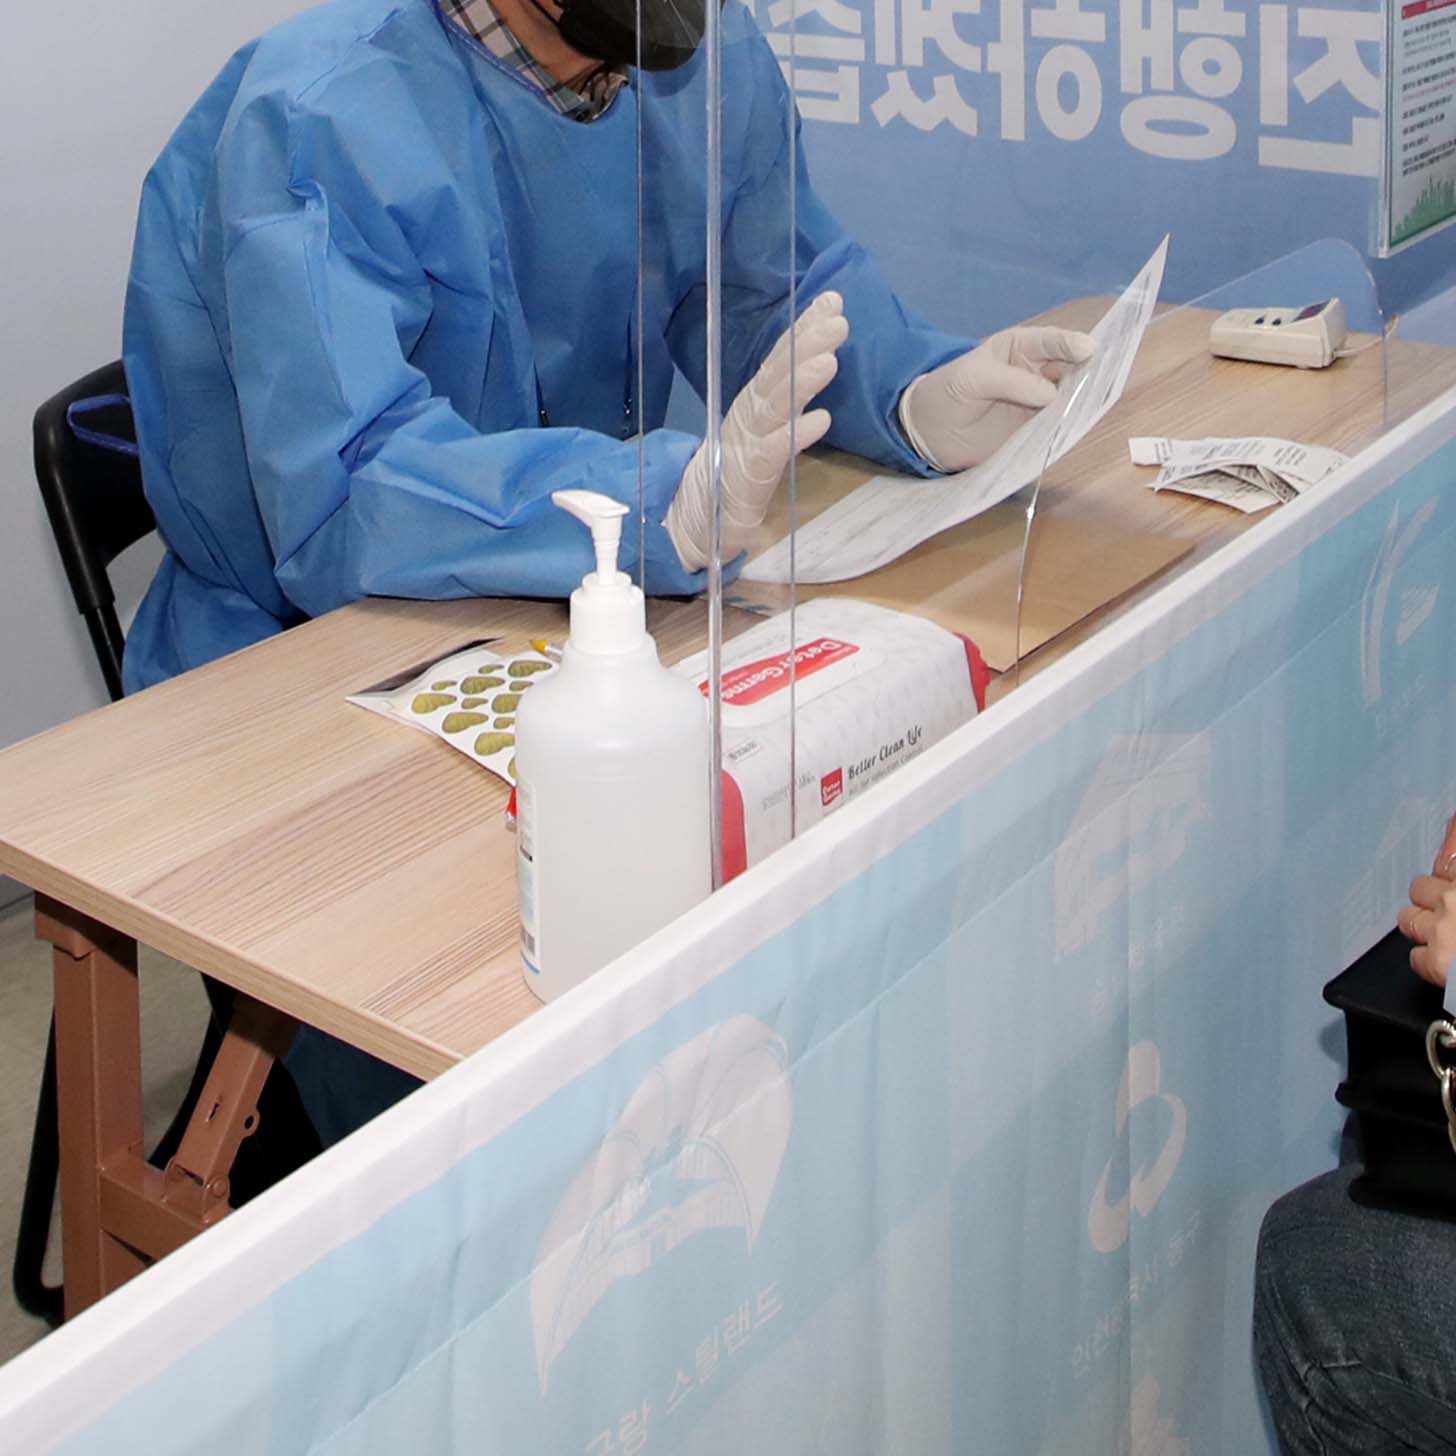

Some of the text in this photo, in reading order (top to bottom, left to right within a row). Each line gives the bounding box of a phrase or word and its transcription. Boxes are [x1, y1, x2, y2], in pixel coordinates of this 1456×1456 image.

[848, 753, 877, 780] Better
[879, 738, 905, 761] Clean
[665, 1279, 786, 1416] 스틸랜드
